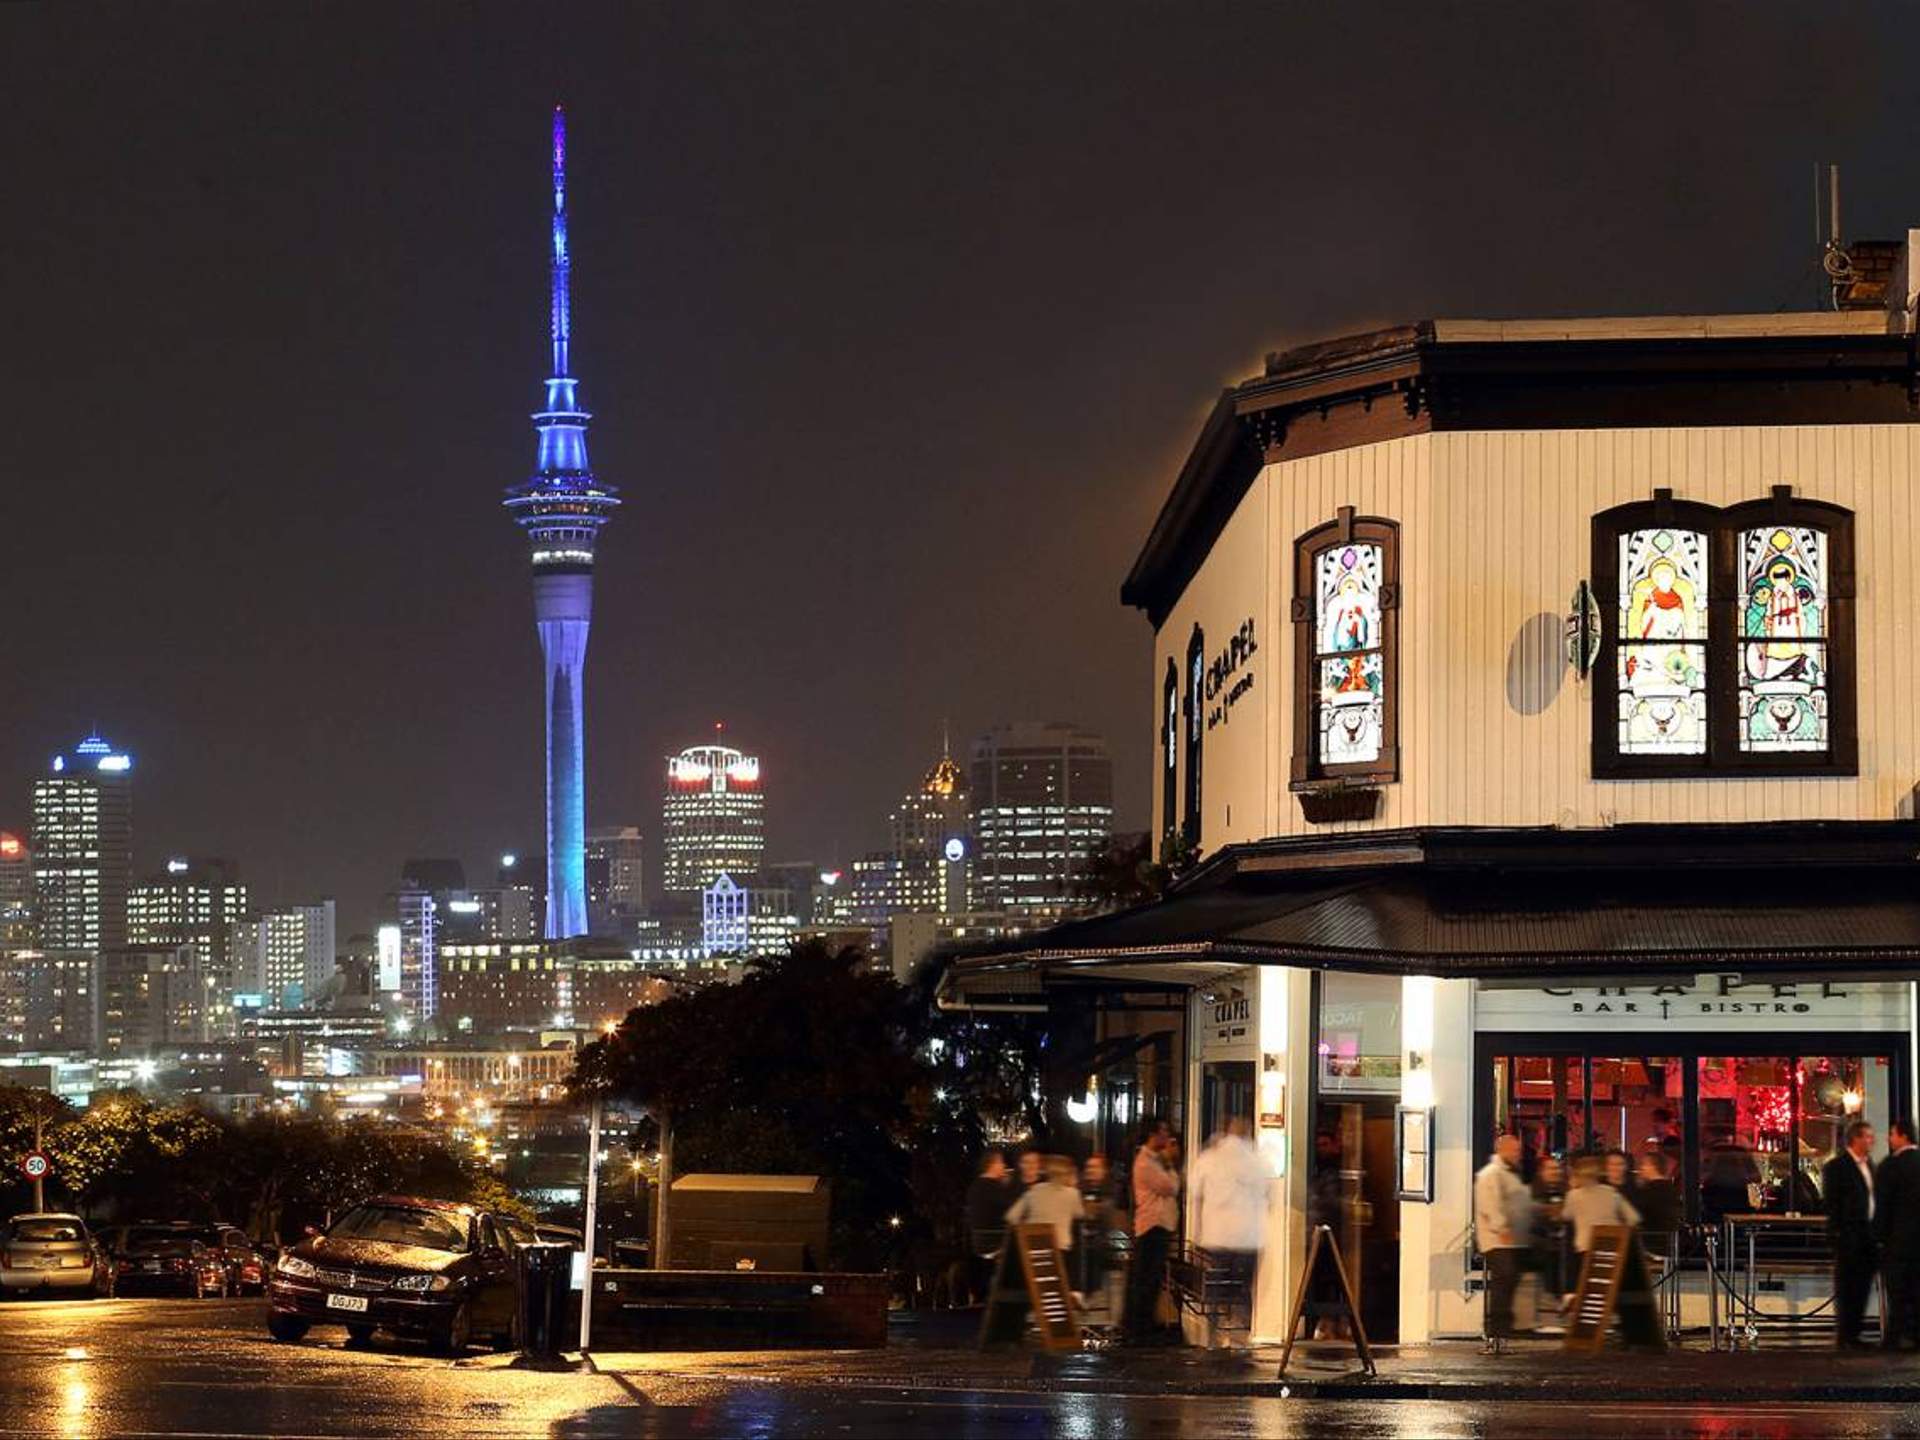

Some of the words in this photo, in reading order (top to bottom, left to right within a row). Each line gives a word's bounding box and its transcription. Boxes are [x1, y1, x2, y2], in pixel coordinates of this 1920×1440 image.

[1572, 1002, 1638, 1013] BAR
[1700, 1002, 1811, 1013] BISTRO
[28, 1159, 45, 1171] 50
